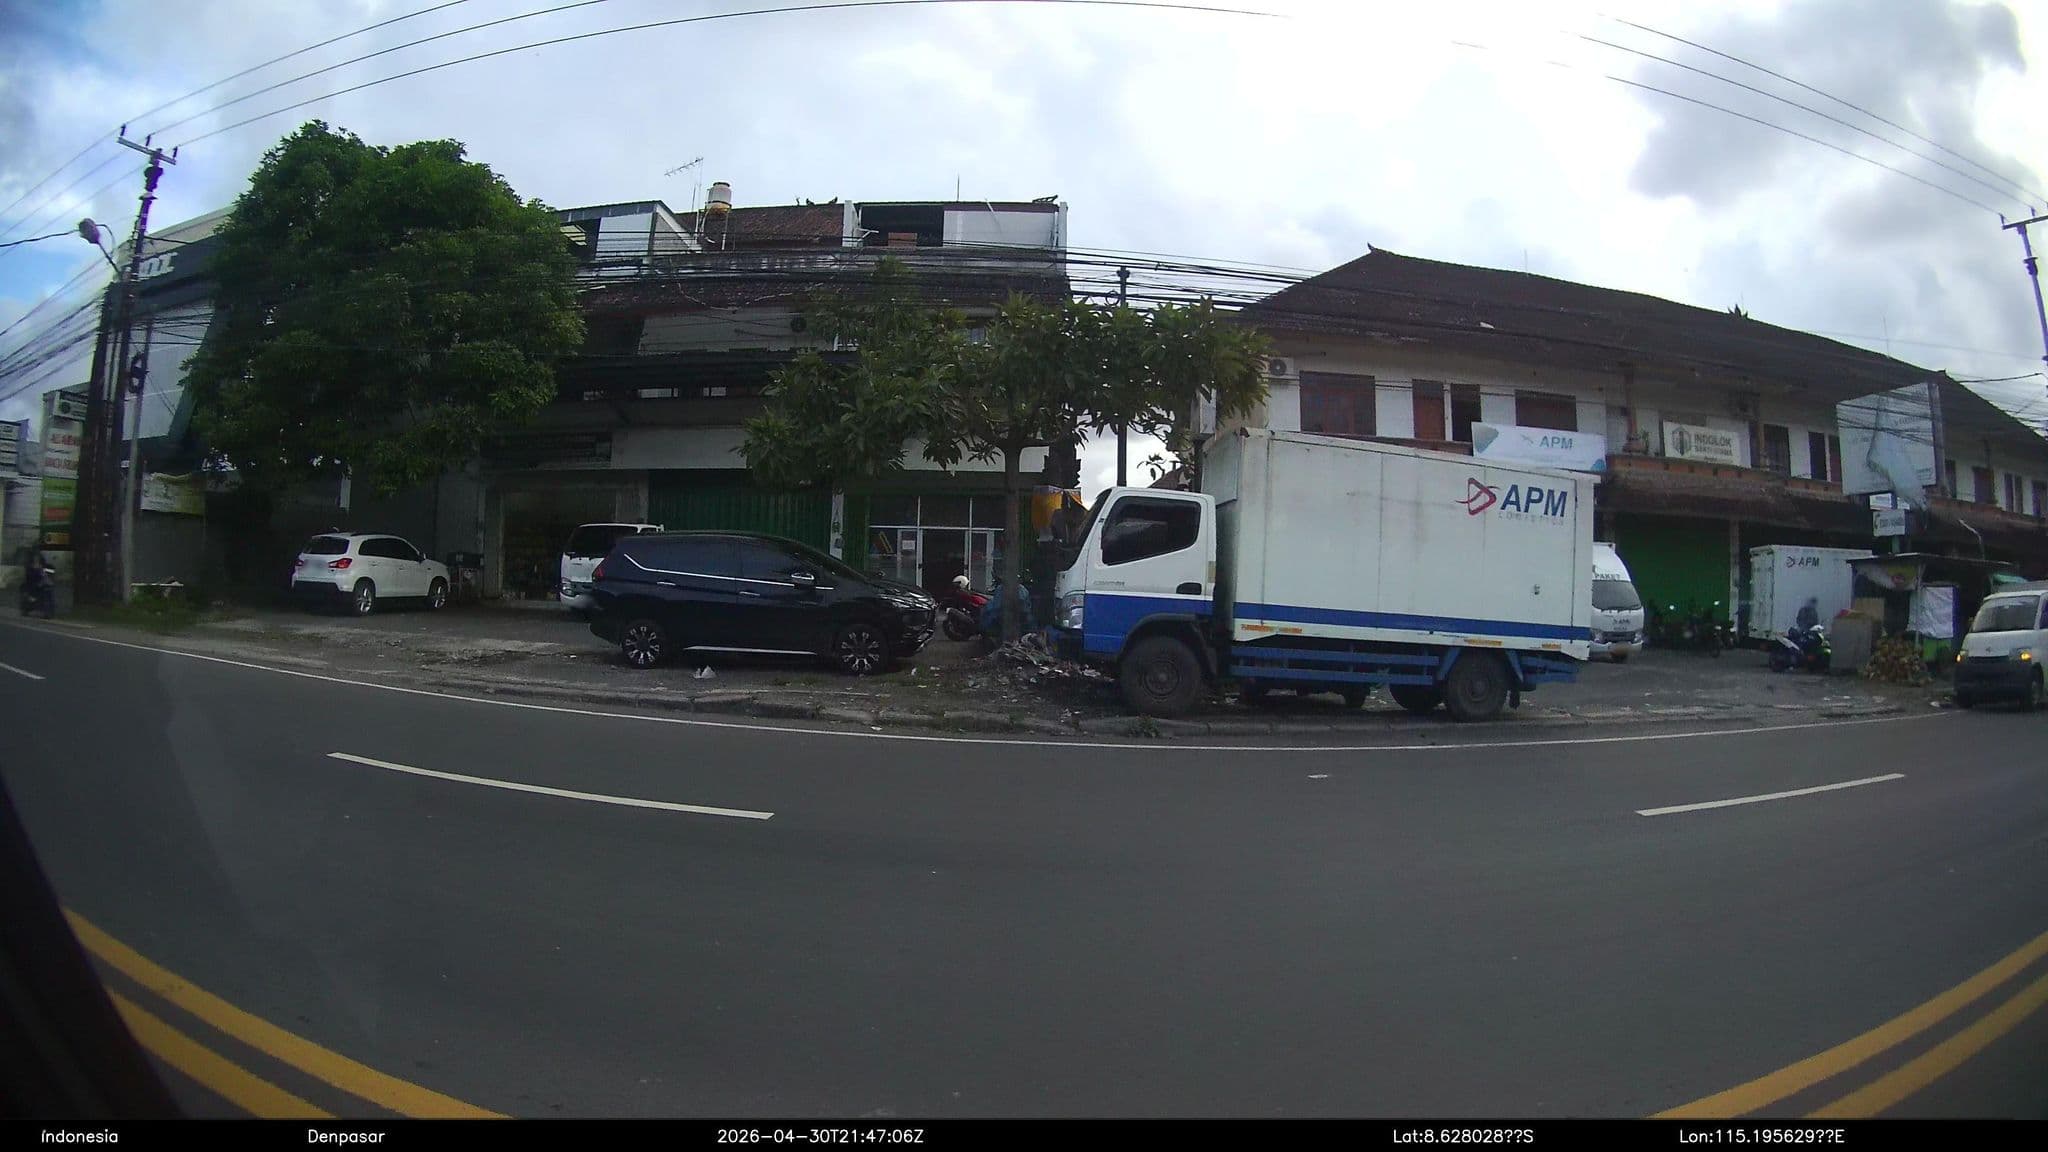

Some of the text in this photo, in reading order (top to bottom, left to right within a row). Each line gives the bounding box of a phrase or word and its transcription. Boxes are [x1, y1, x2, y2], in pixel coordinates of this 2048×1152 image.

[1539, 435, 1573, 449] APM
[1500, 484, 1568, 517] APM
[1798, 556, 1820, 568] APM
